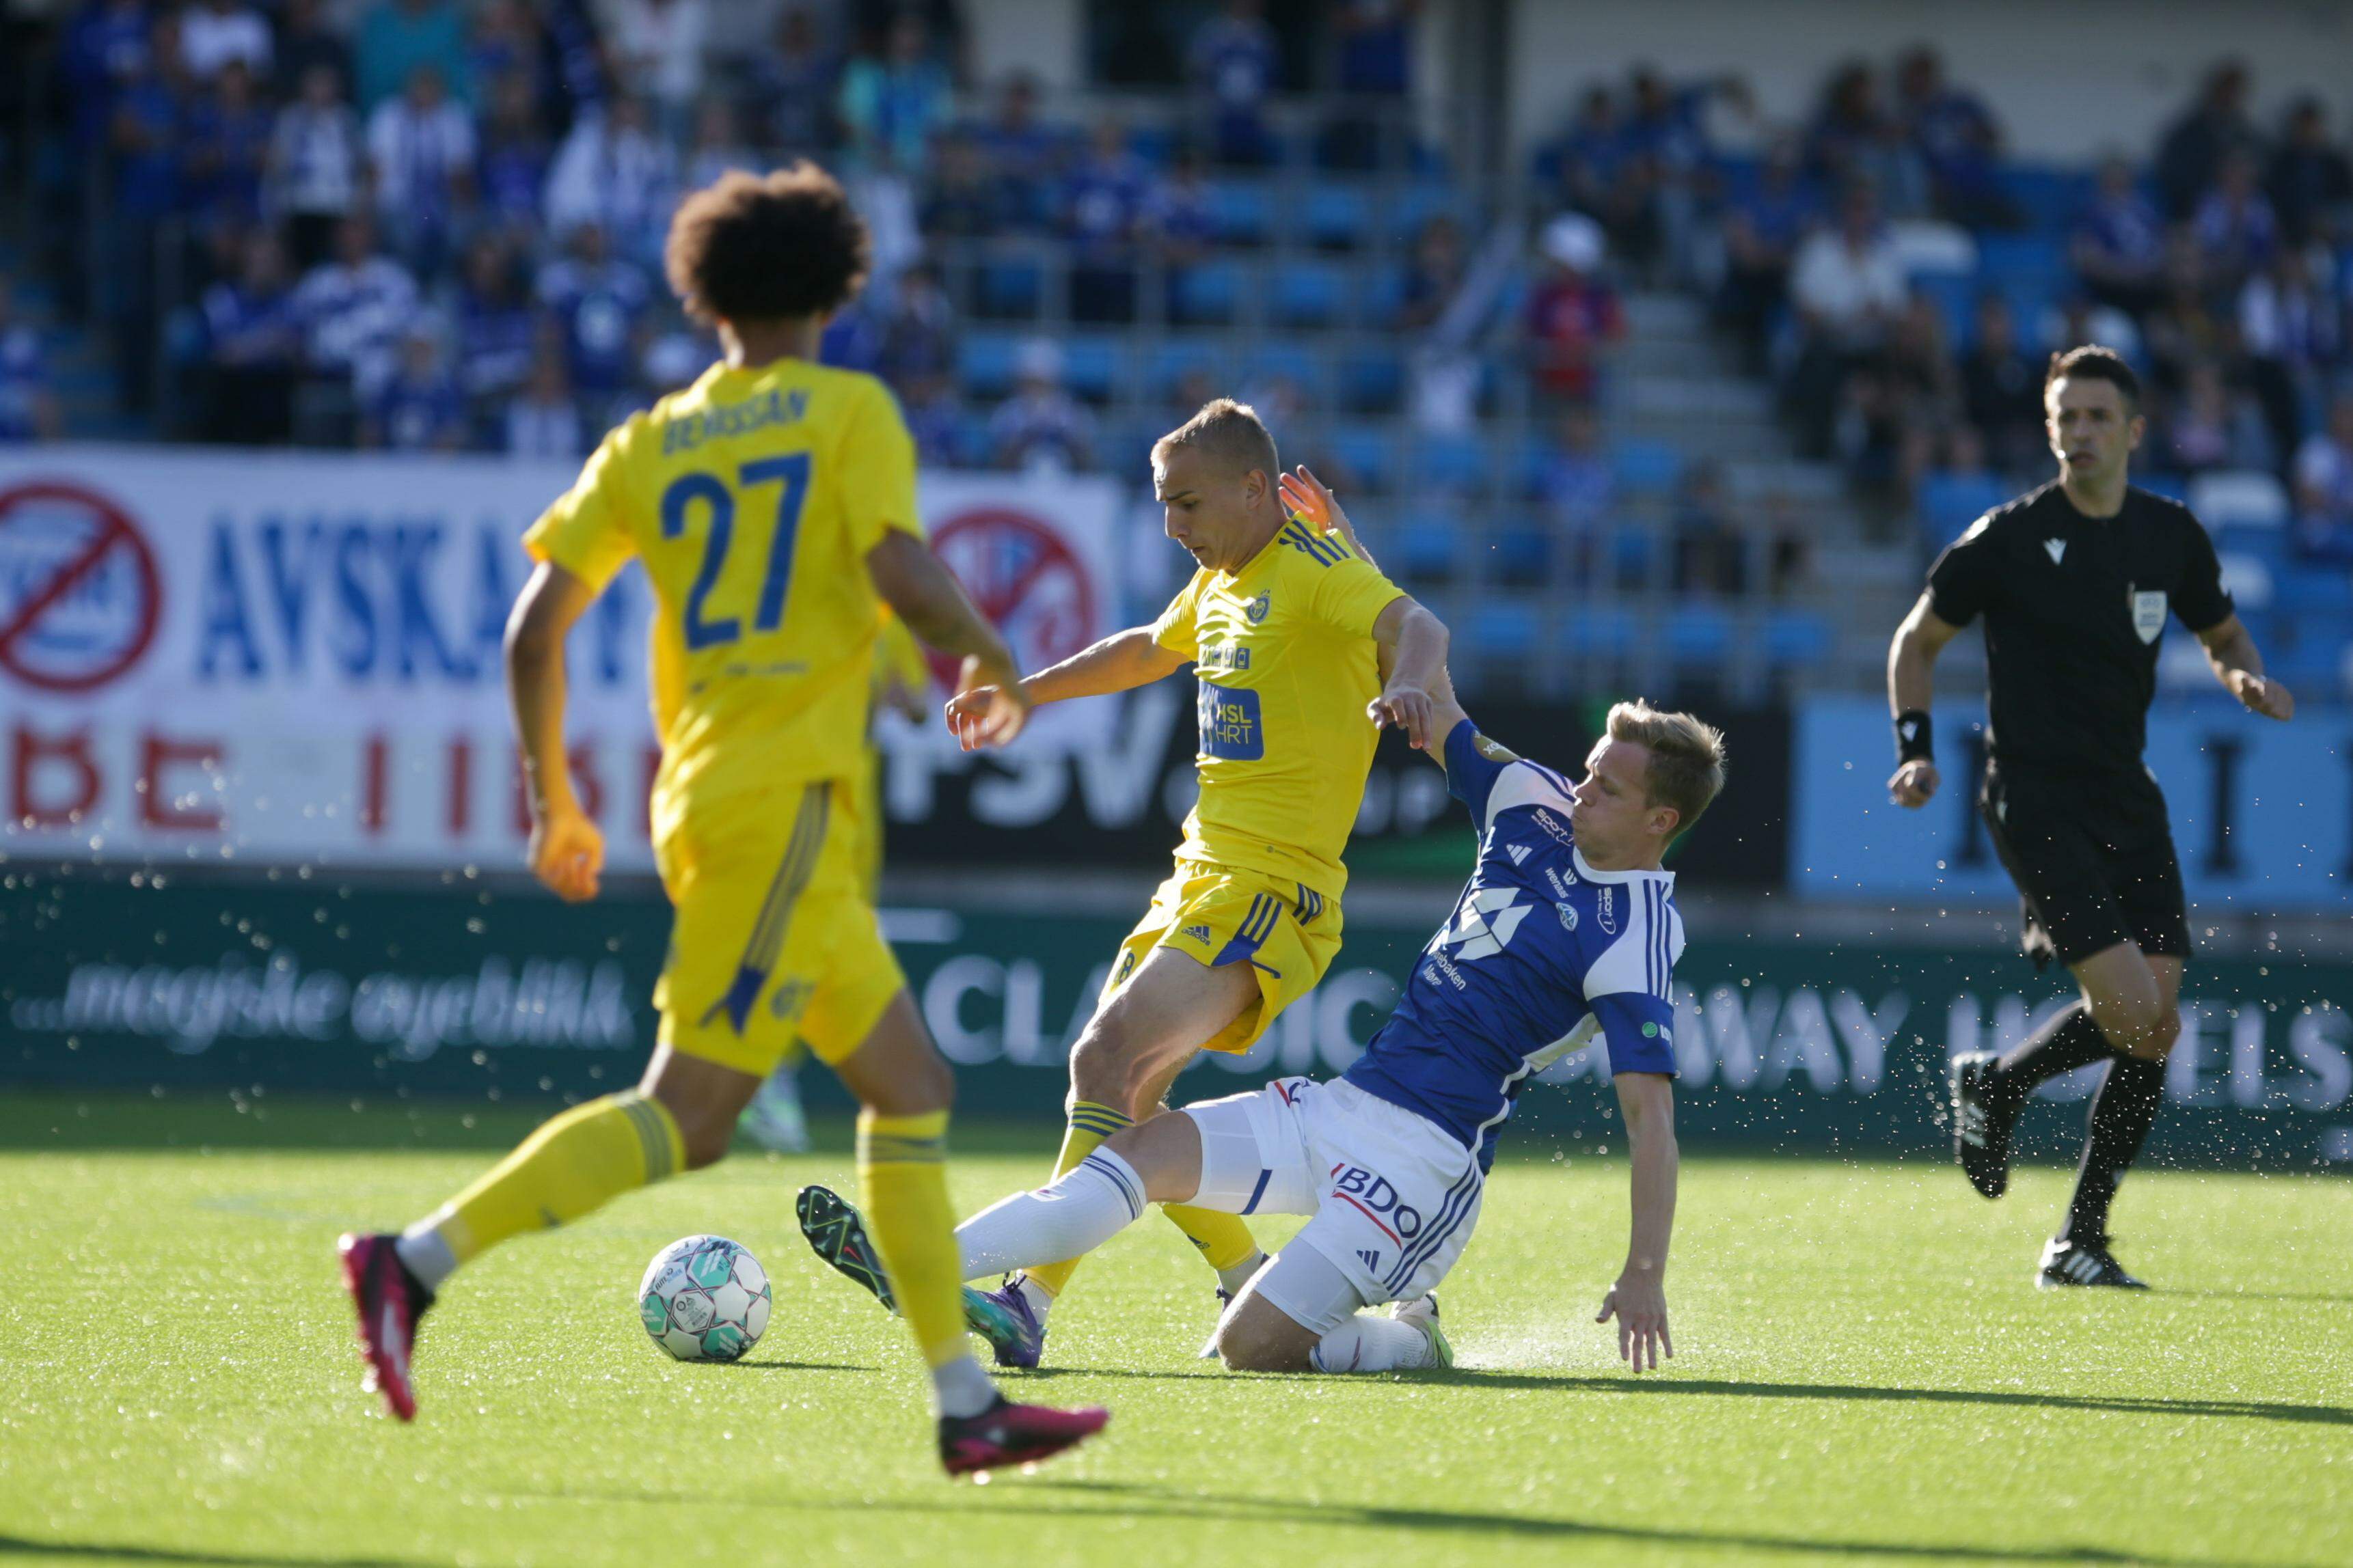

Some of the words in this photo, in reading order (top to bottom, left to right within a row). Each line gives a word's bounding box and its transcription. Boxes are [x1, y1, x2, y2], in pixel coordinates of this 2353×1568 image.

[659, 450, 812, 651] 27
[1216, 704, 1252, 724] HSL
[1214, 724, 1253, 744] HRT
[1603, 887, 1613, 918] sport
[1181, 928, 1211, 946] adidas
[1335, 1167, 1422, 1239] BDO
